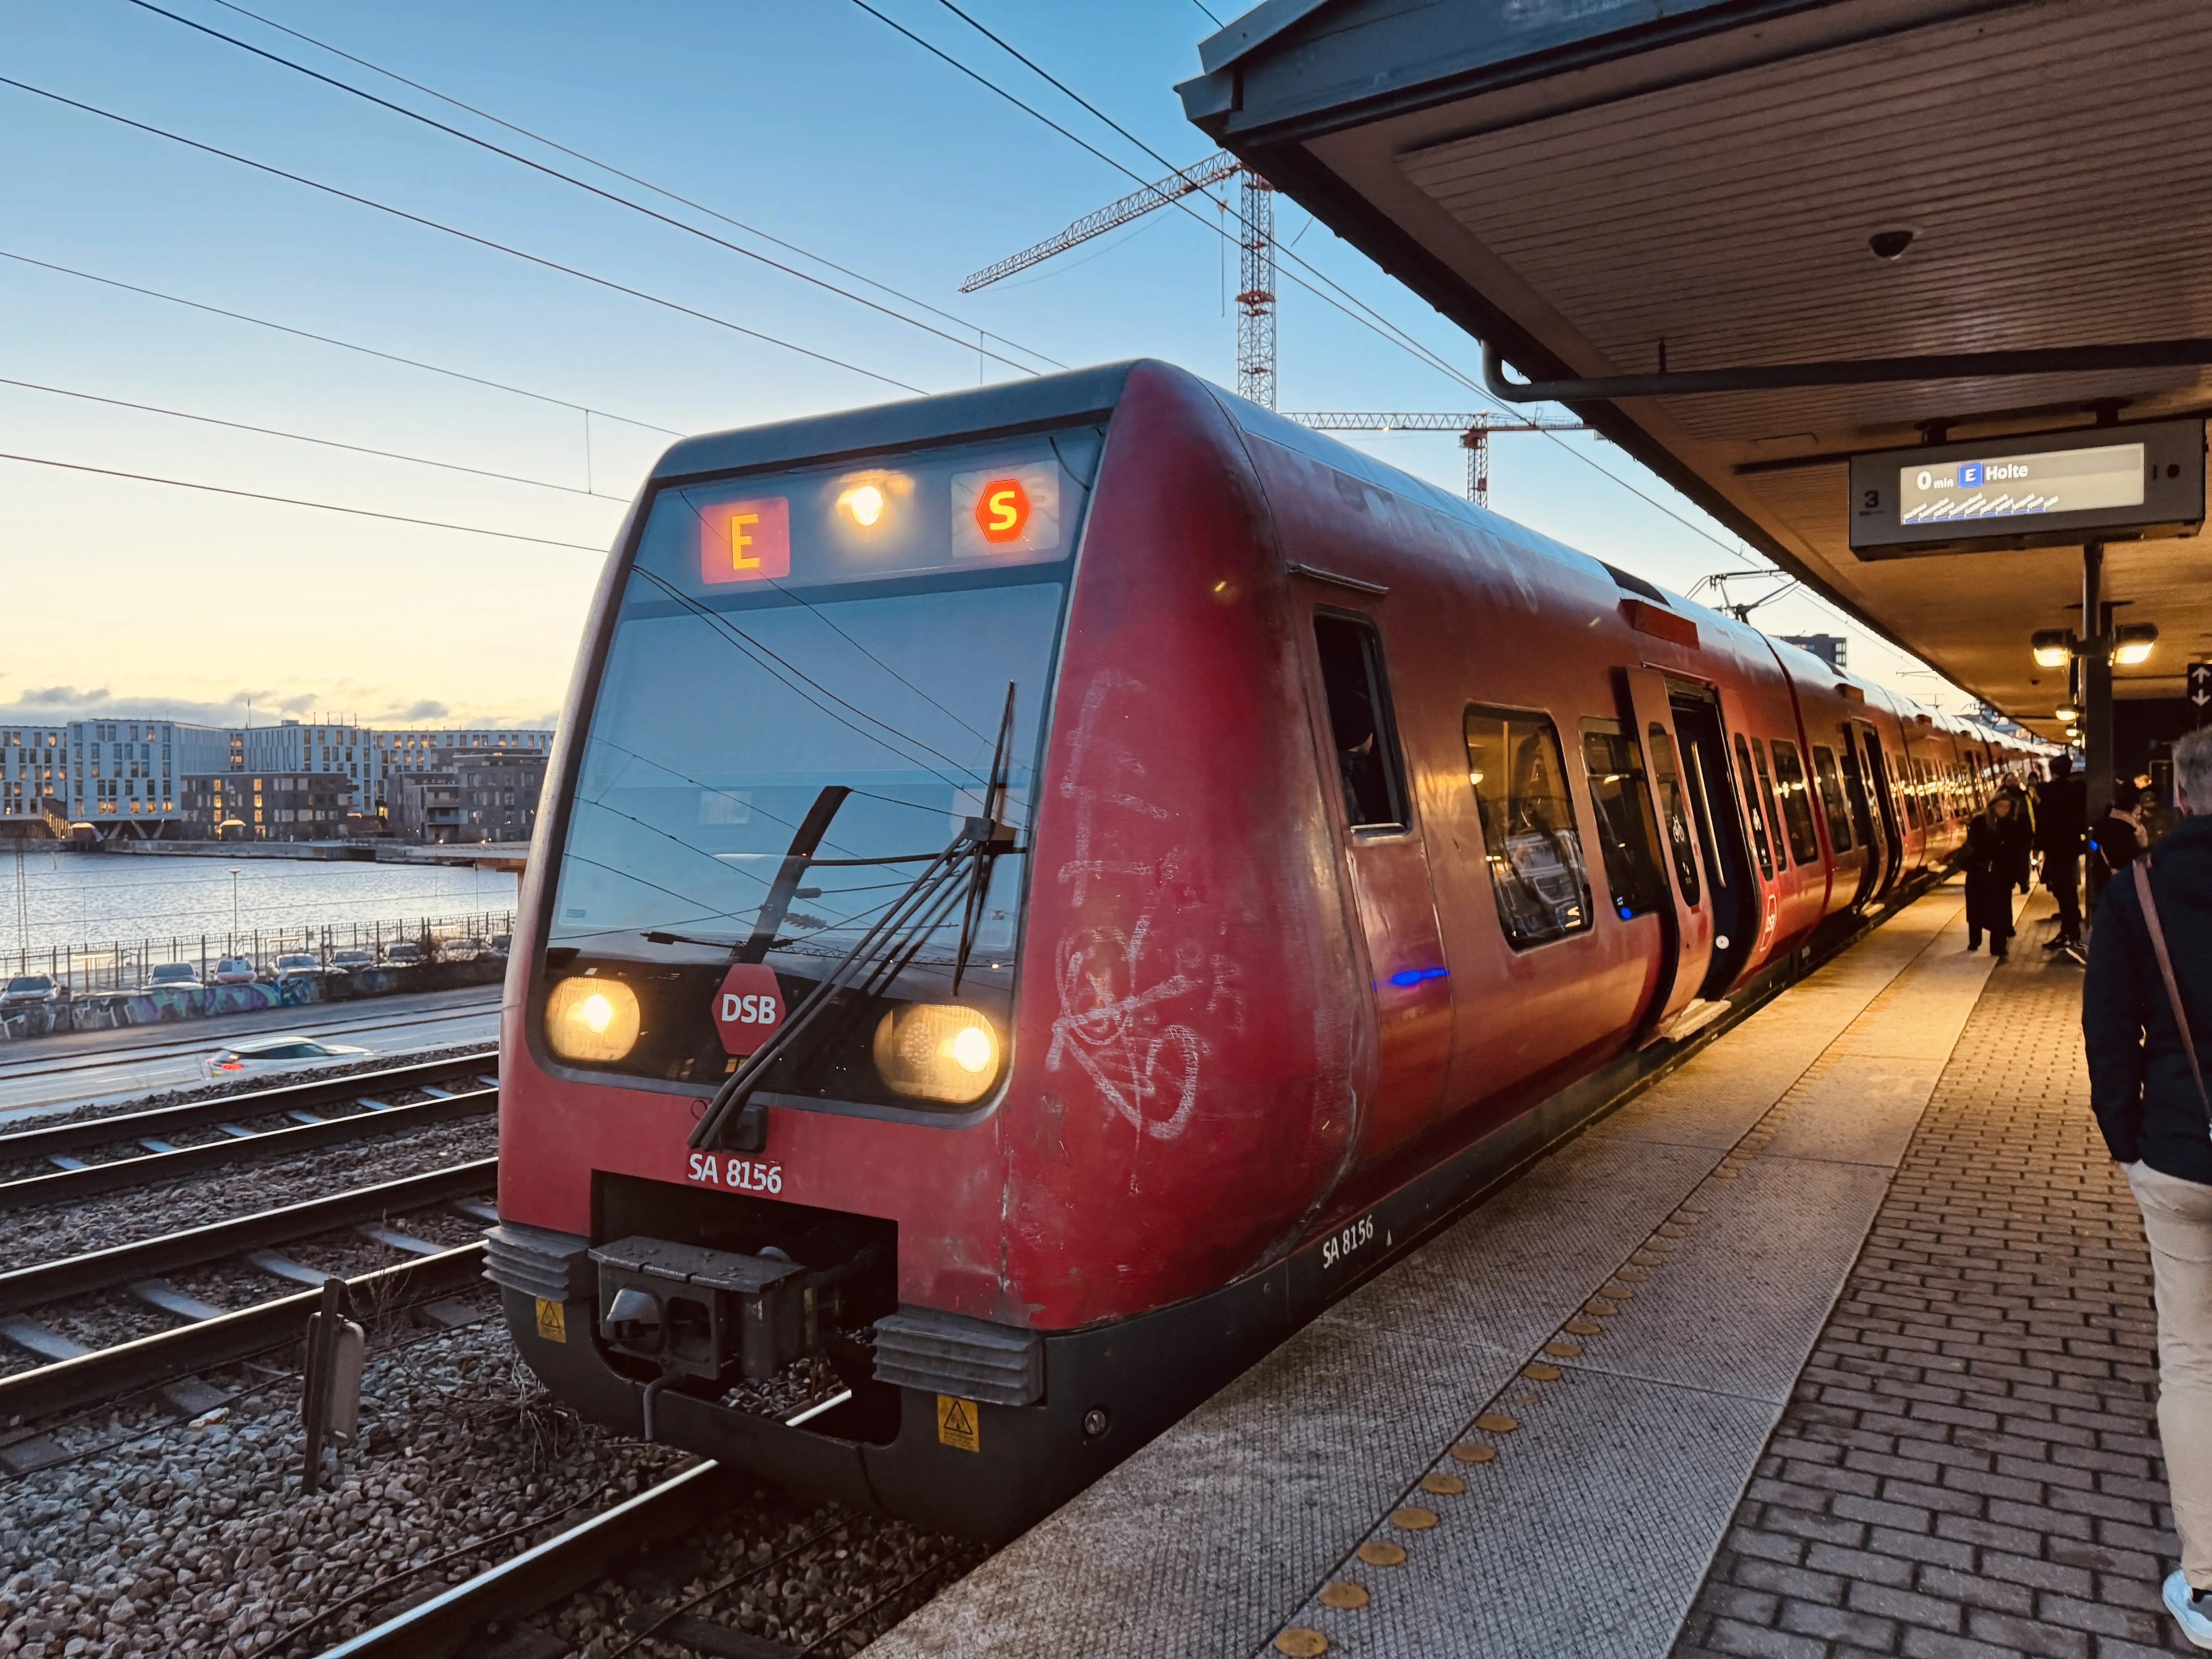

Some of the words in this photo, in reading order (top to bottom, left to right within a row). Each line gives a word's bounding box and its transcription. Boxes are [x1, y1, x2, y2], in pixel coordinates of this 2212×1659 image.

[1917, 471, 1932, 490] 0
[1934, 477, 1954, 489] min
[1965, 468, 1976, 482] E
[1985, 464, 2028, 481] Holte
[989, 491, 1017, 531] S
[1865, 490, 1879, 508] 3
[731, 514, 760, 570] E
[721, 994, 776, 1025] DSB
[688, 1153, 718, 1183] SA
[726, 1159, 782, 1194] 8156
[1322, 1237, 1340, 1269] SA
[1342, 1214, 1374, 1255] 8156
